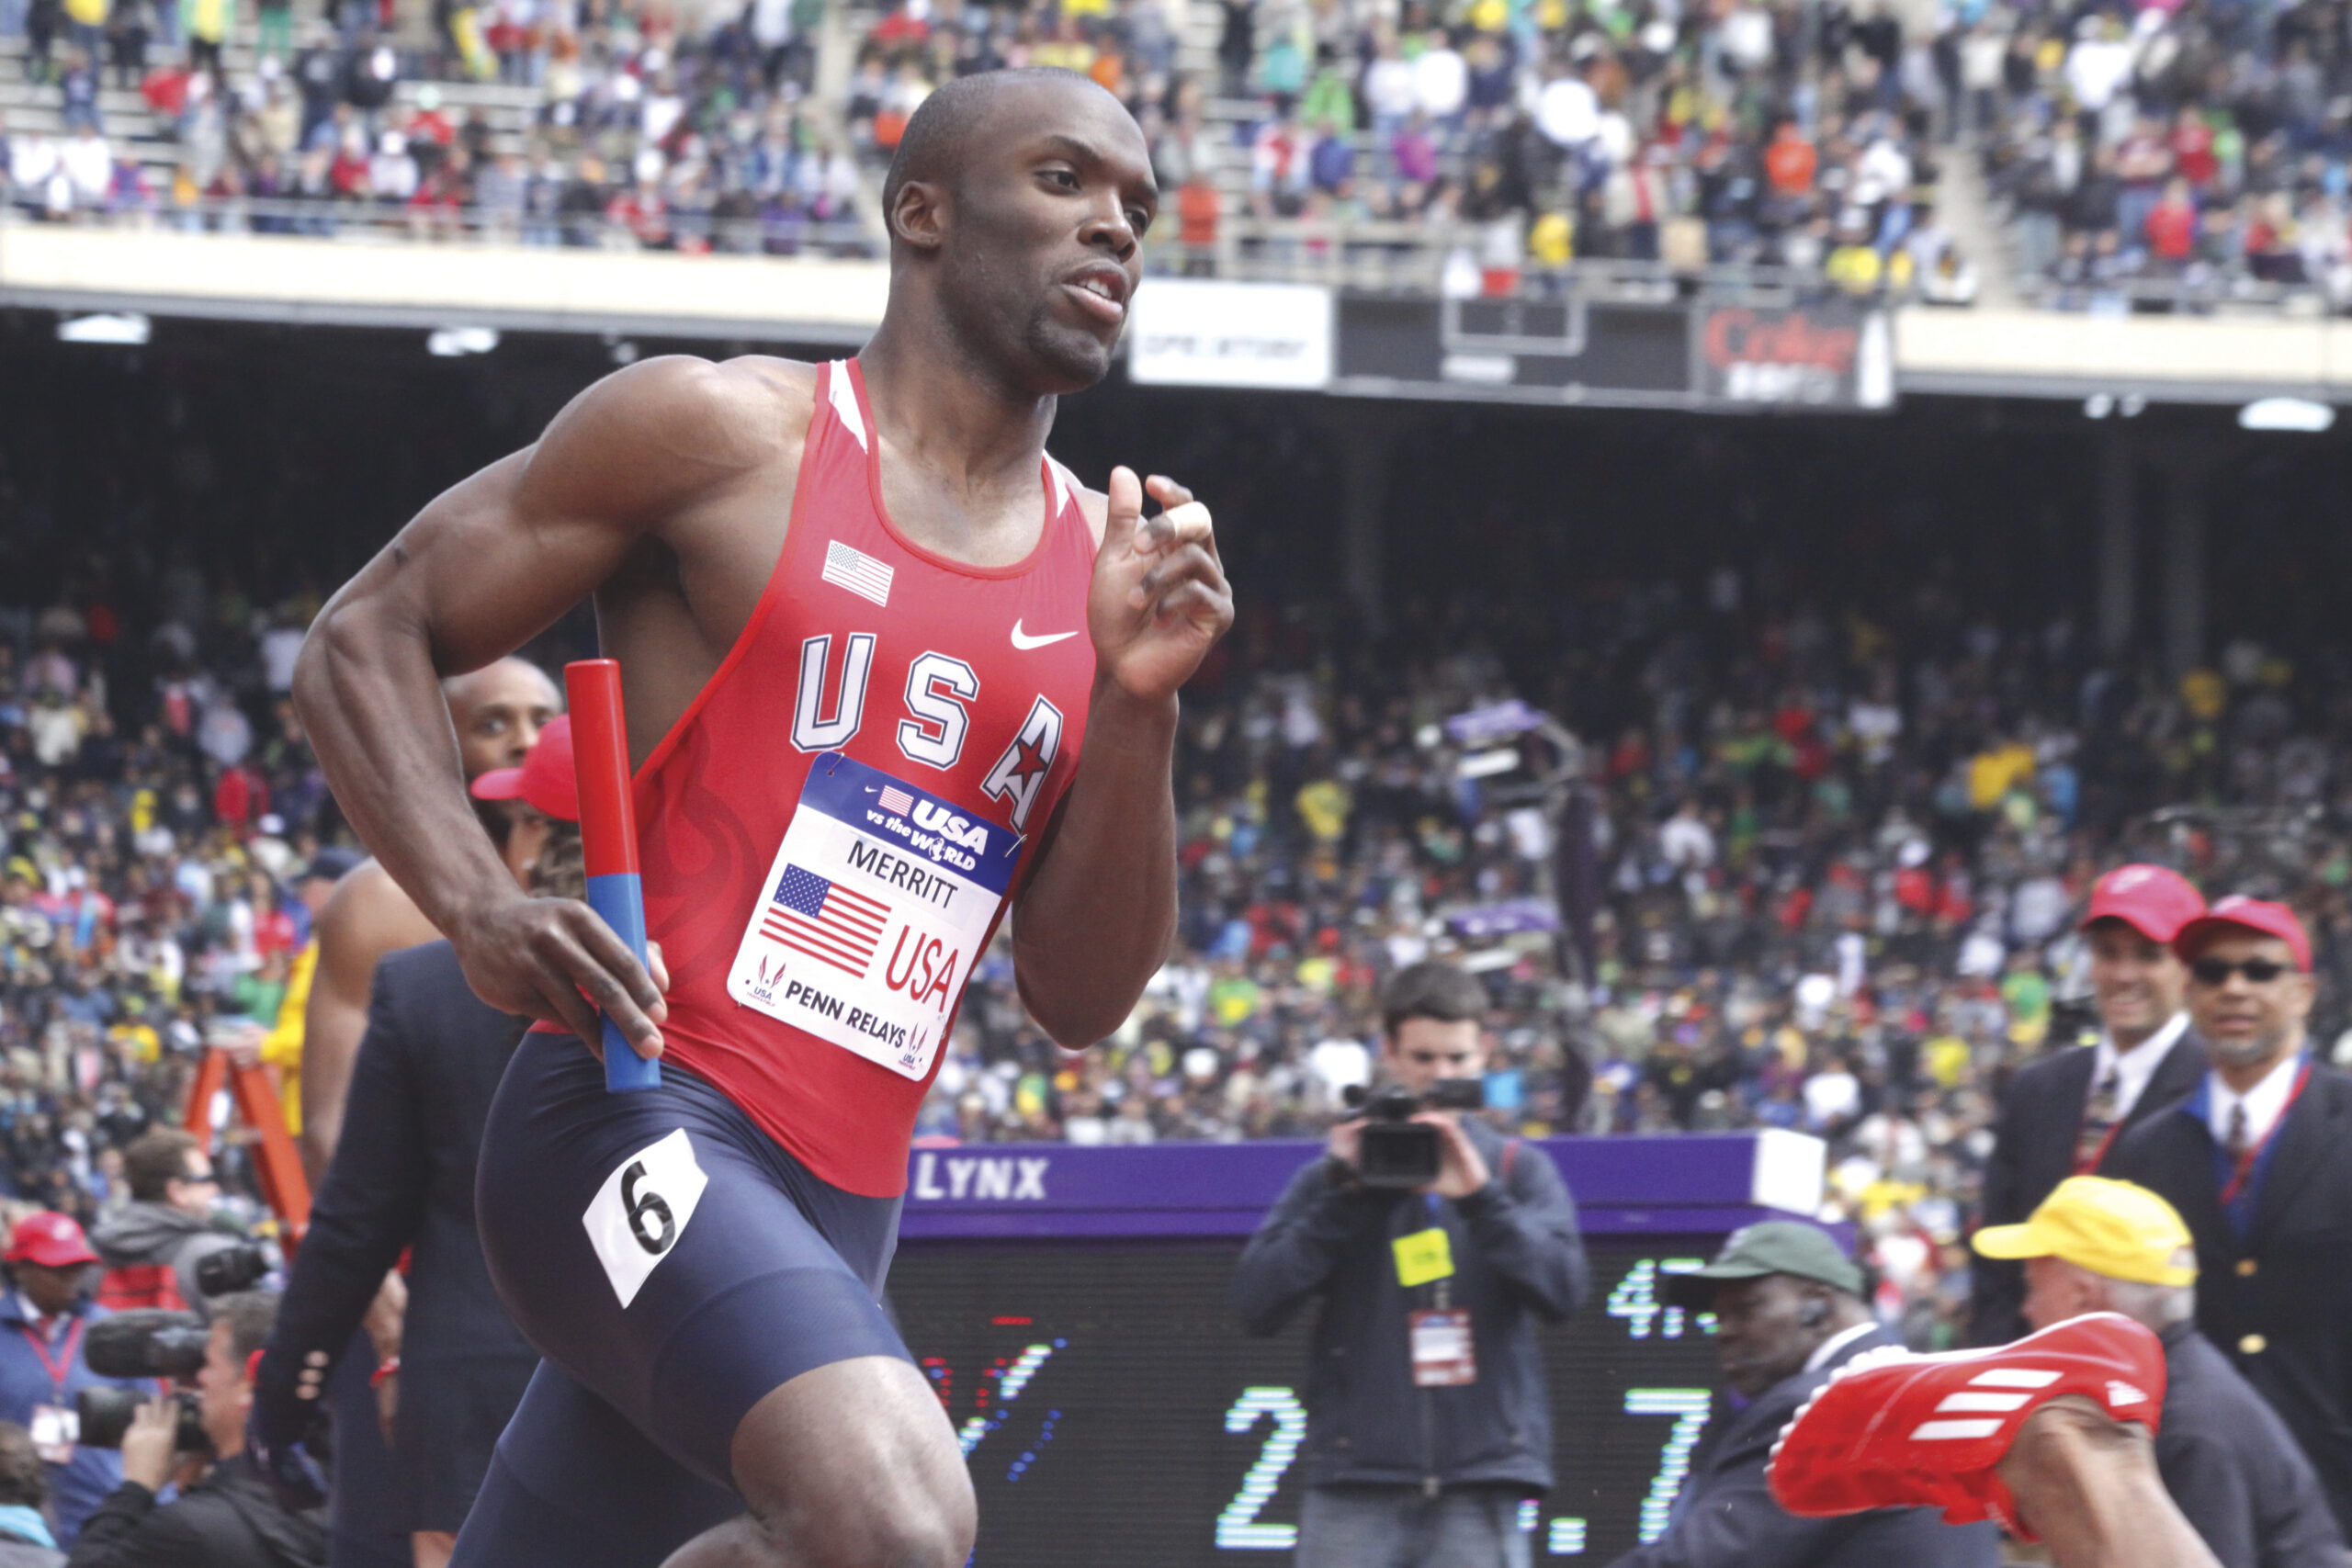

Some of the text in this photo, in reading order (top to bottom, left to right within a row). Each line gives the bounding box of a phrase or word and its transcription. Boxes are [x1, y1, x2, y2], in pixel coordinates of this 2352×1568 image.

[790, 632, 1064, 836] USA
[866, 809, 885, 825] vs
[885, 818, 911, 837] the
[912, 799, 989, 856] USA
[847, 840, 959, 908] MERRITT
[753, 986, 773, 1000] USA
[886, 925, 959, 1012] USA
[786, 979, 906, 1048] PENN RELAYS
[621, 1160, 675, 1256] 6
[915, 1152, 1049, 1200] LYNX
